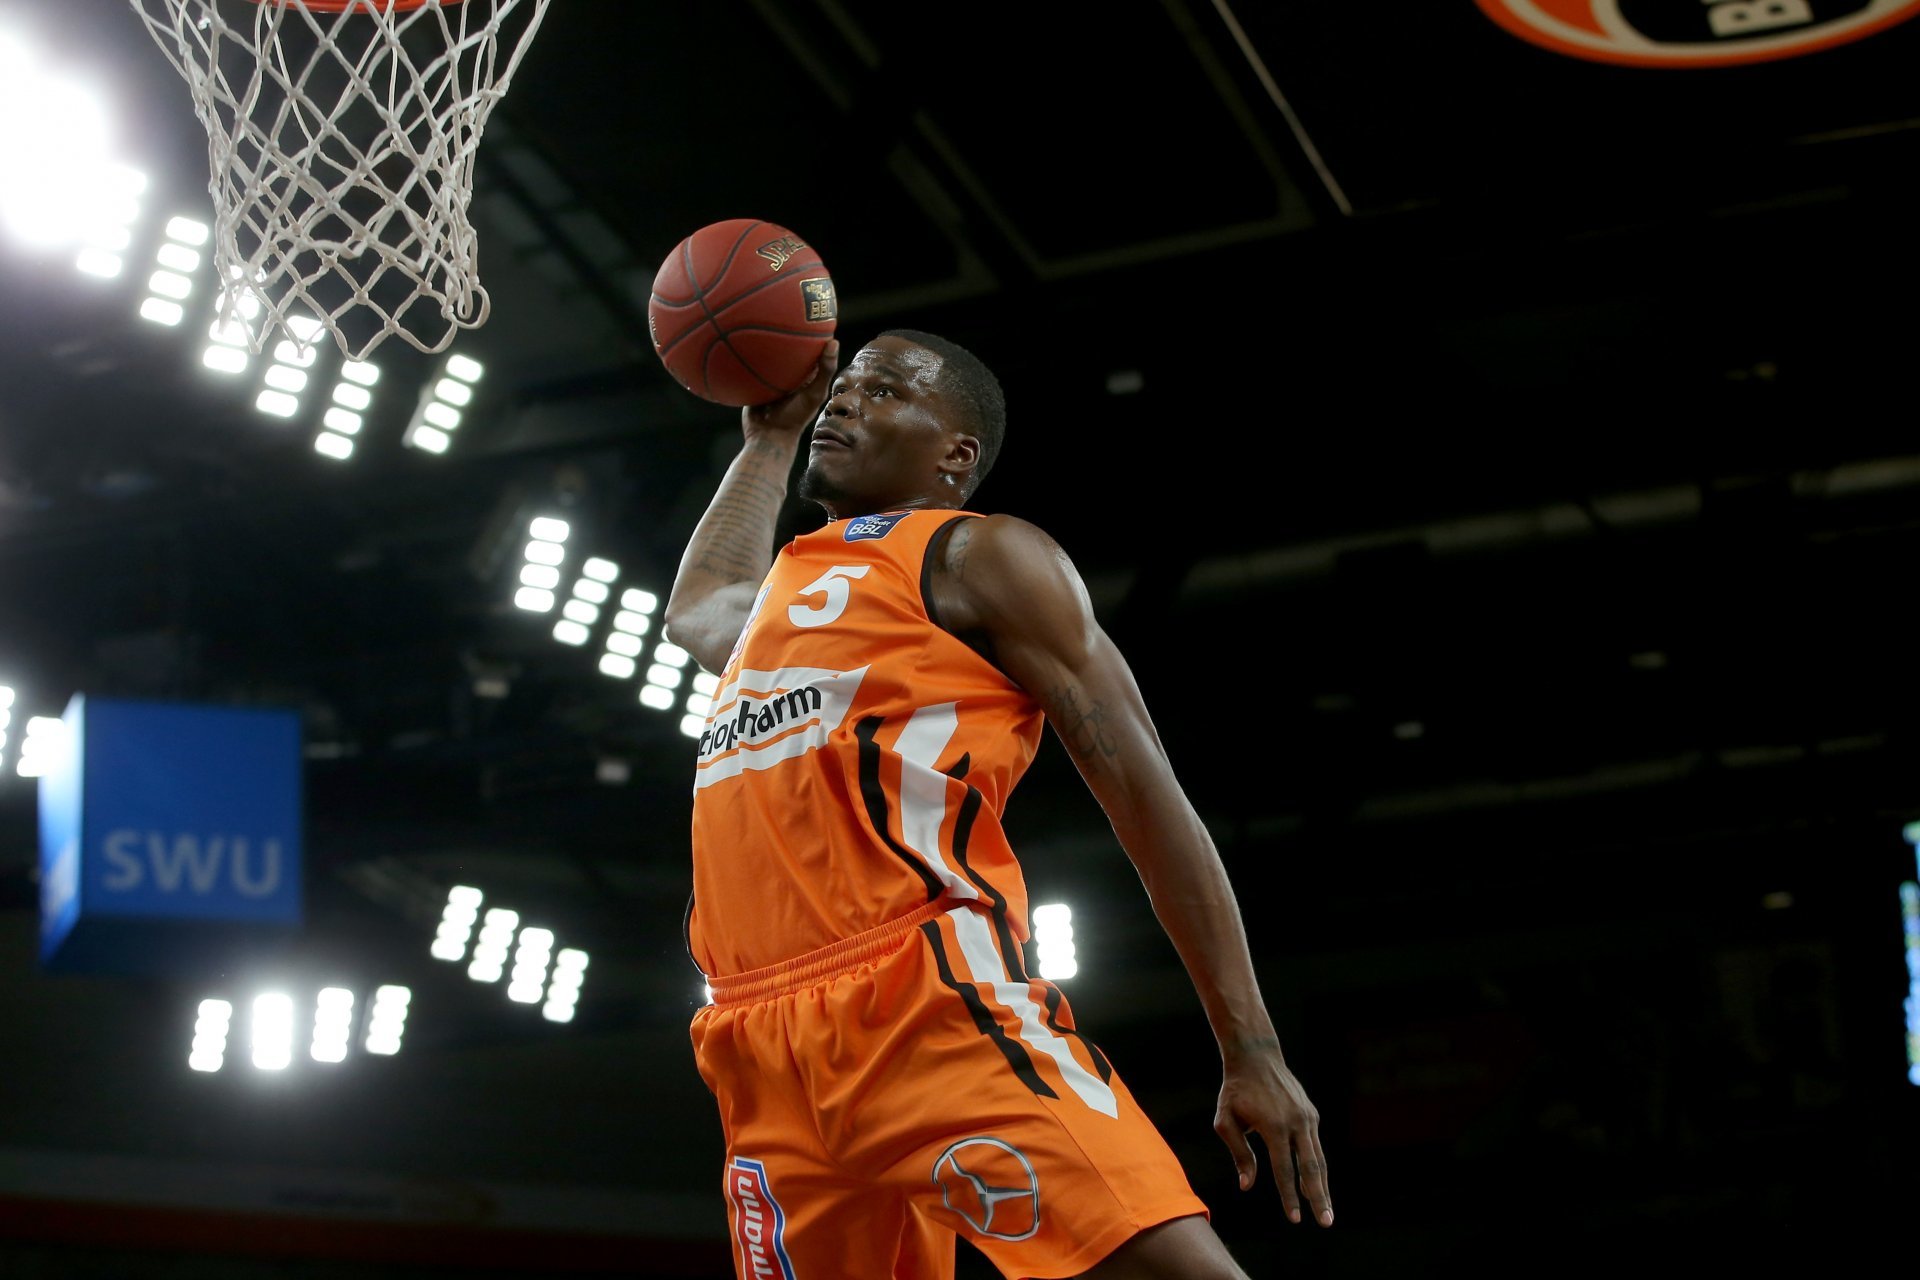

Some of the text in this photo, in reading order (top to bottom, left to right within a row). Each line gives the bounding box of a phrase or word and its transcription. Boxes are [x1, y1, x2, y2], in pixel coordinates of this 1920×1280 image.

[810, 300, 832, 319] BBL
[848, 523, 882, 535] BBL
[788, 565, 871, 628] 5
[103, 829, 283, 898] SWU
[738, 1175, 774, 1280] mann
